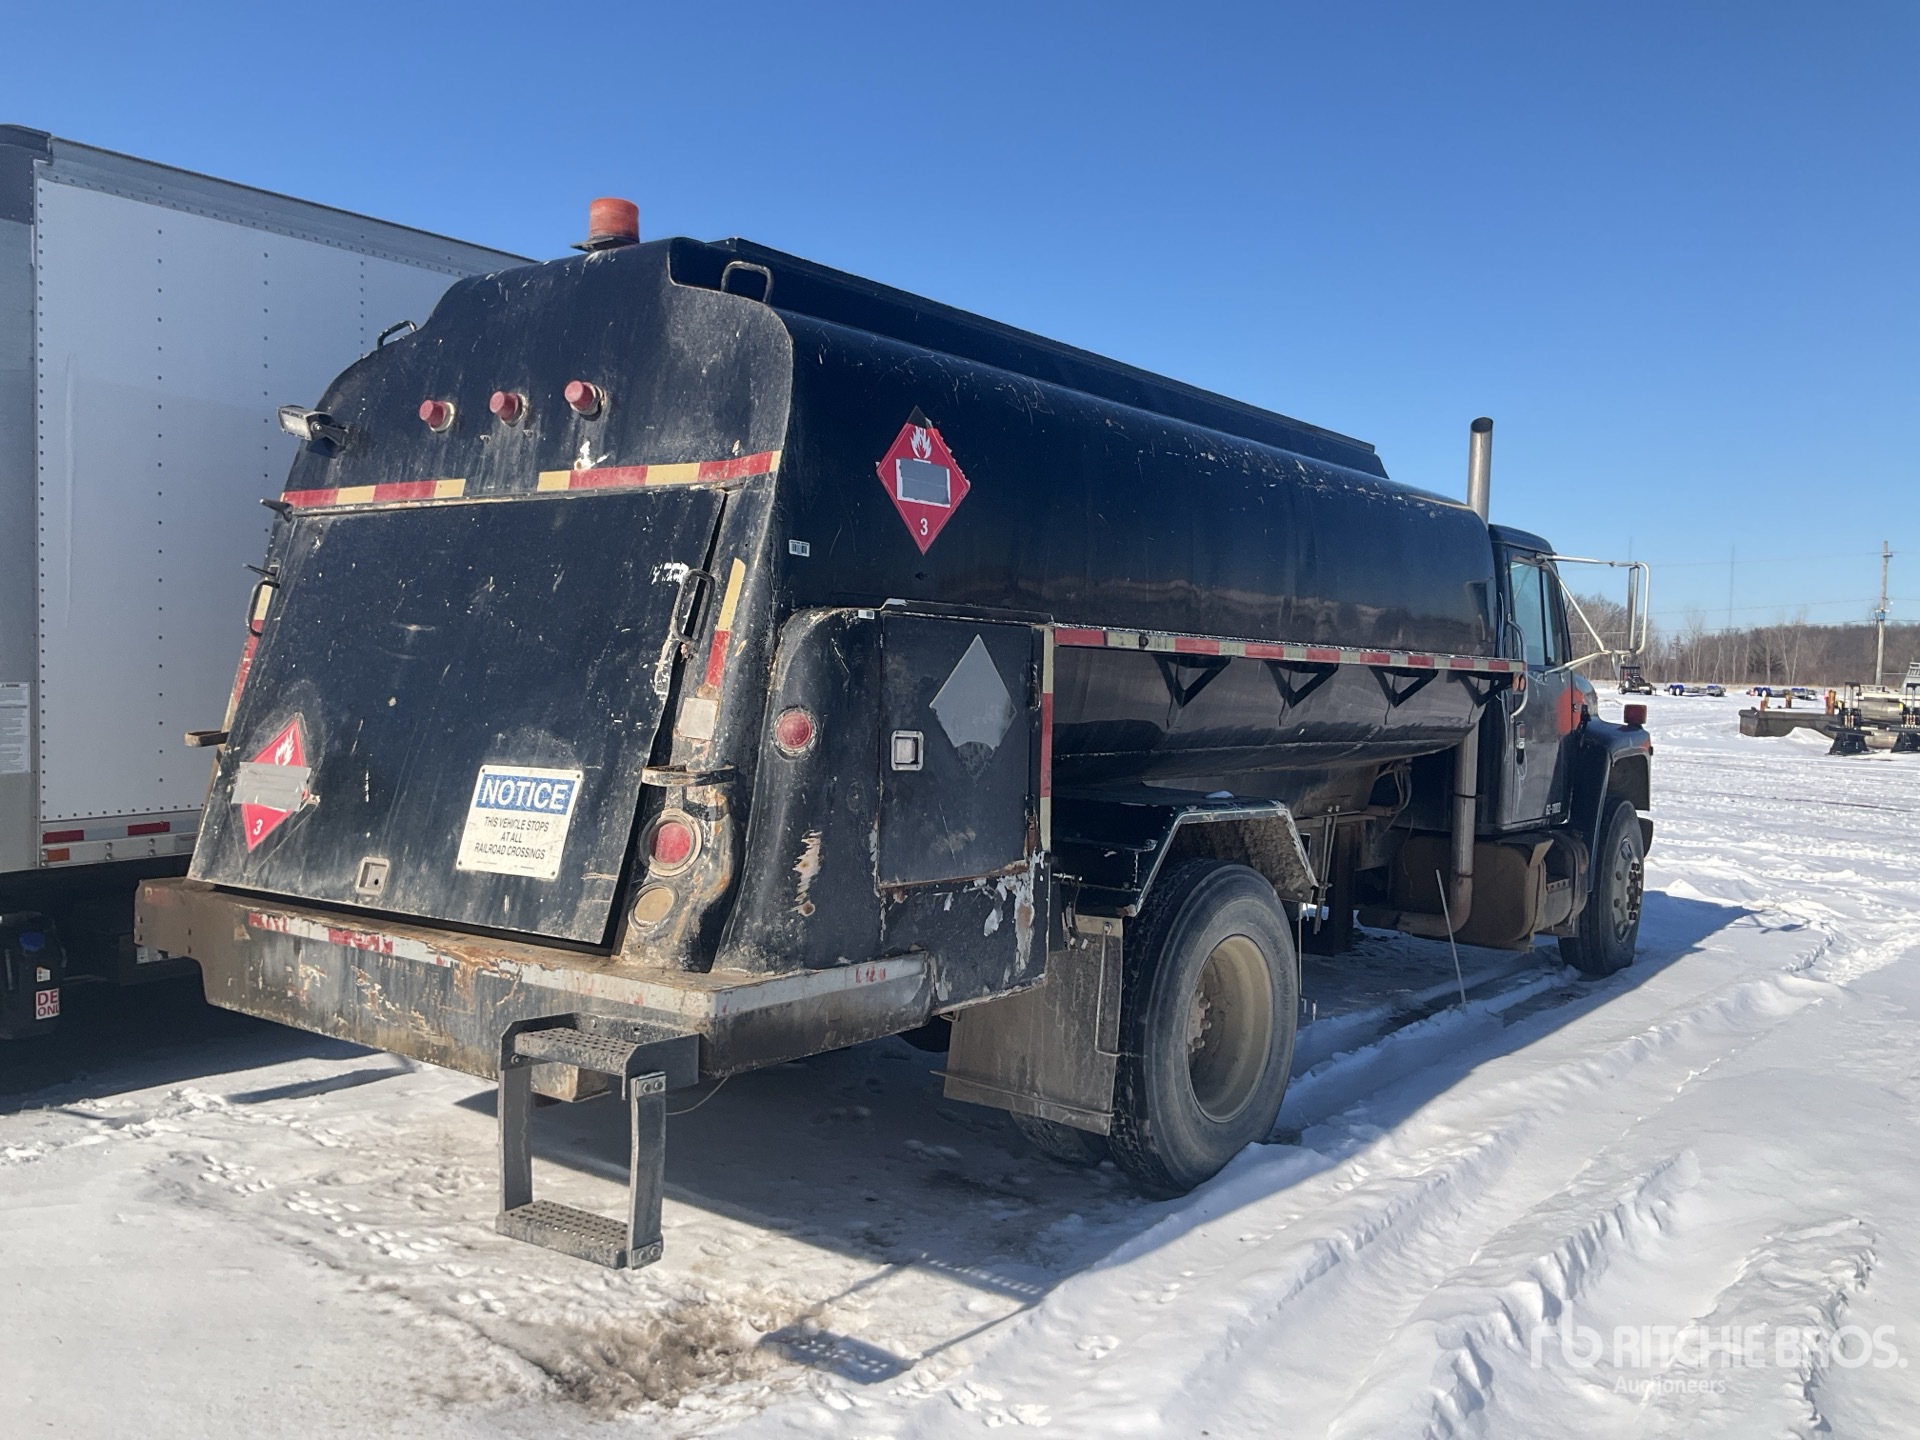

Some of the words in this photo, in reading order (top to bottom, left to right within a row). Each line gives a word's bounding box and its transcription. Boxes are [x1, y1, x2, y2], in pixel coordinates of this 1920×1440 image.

[920, 518, 929, 536] 3
[482, 779, 568, 809] NOTICE
[253, 819, 263, 835] 3
[485, 816, 499, 827] THIS
[499, 818, 526, 831] VEHICLE
[526, 820, 549, 832] STOPS
[501, 832, 510, 842] AT
[510, 833, 523, 843] ALL
[475, 843, 506, 855] RAILROAD
[506, 845, 546, 860] CROSSINGS
